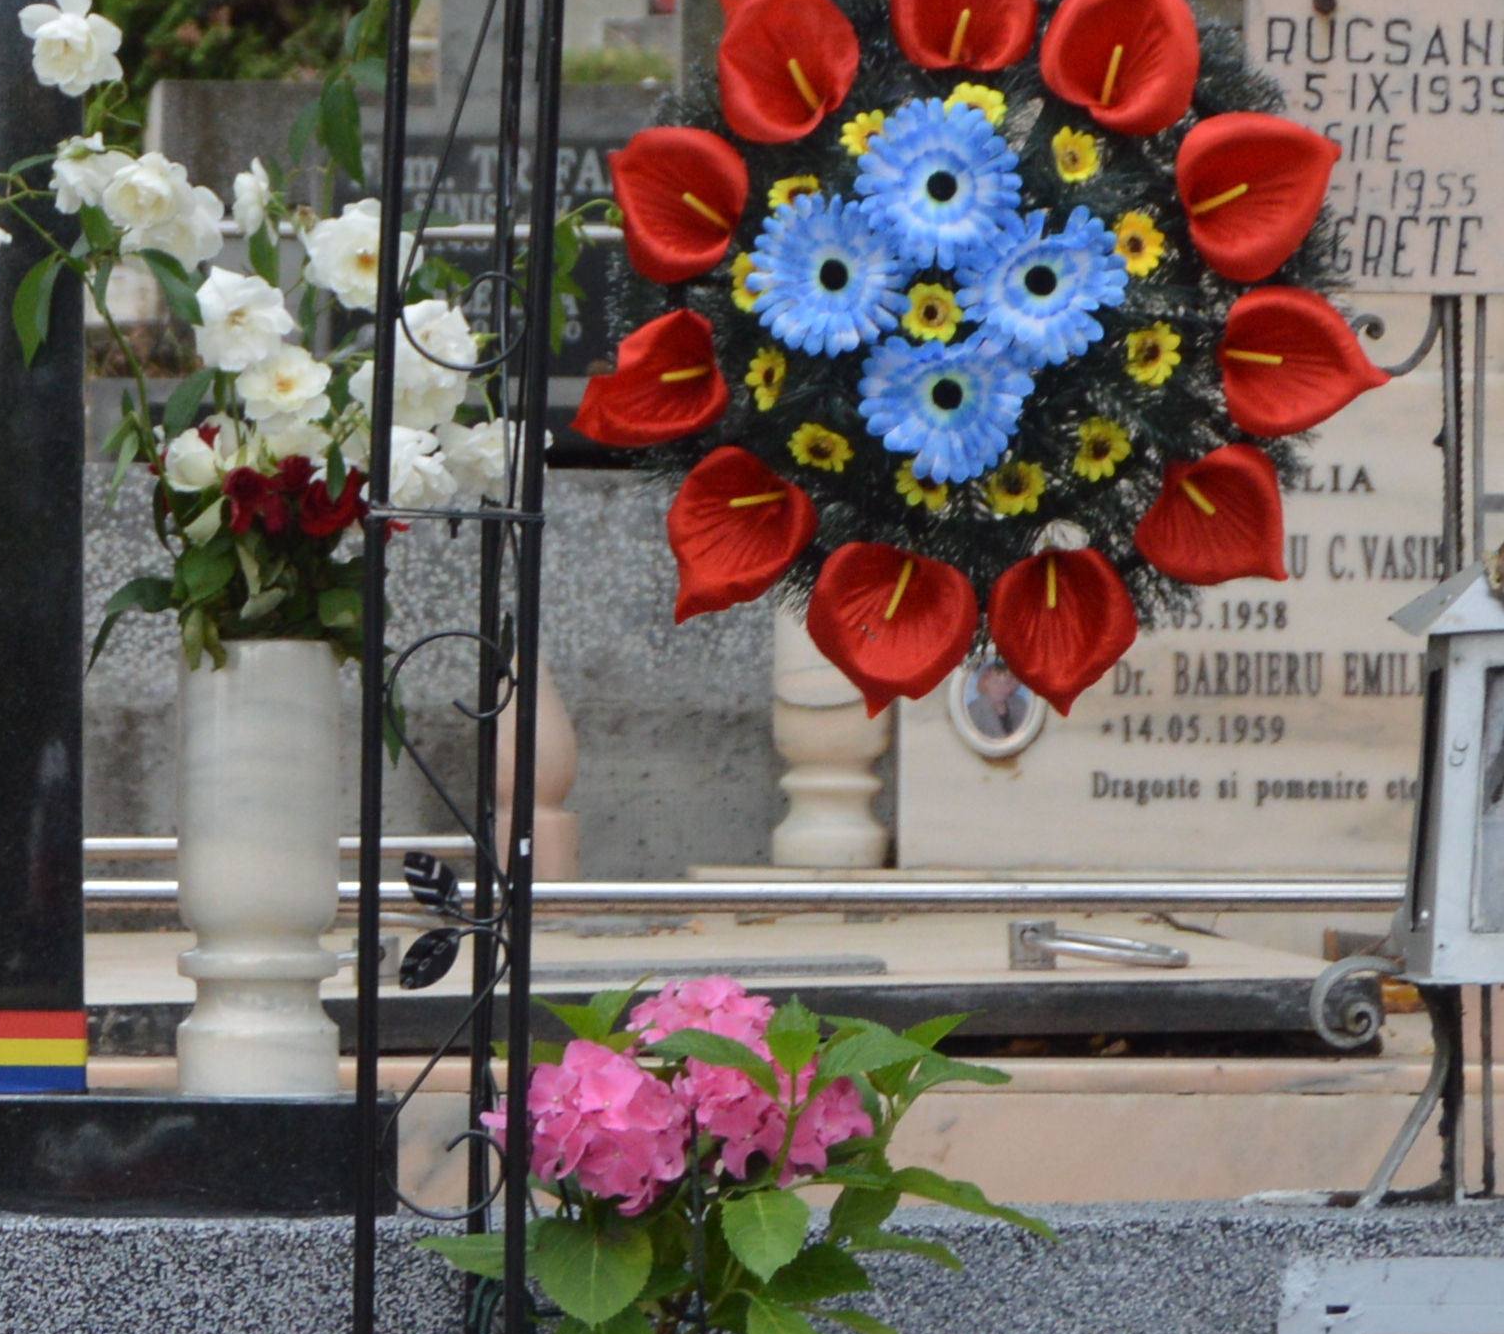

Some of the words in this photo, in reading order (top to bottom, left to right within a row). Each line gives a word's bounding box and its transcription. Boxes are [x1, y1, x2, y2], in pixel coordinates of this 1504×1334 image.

[1330, 216, 1483, 278] GRETE
[1113, 659, 1154, 697] Dr.
[1173, 651, 1324, 697] BARBIERU
[1091, 770, 1201, 805] Dragoste
[1217, 771, 1239, 800] si
[1255, 771, 1369, 807] pomenire
